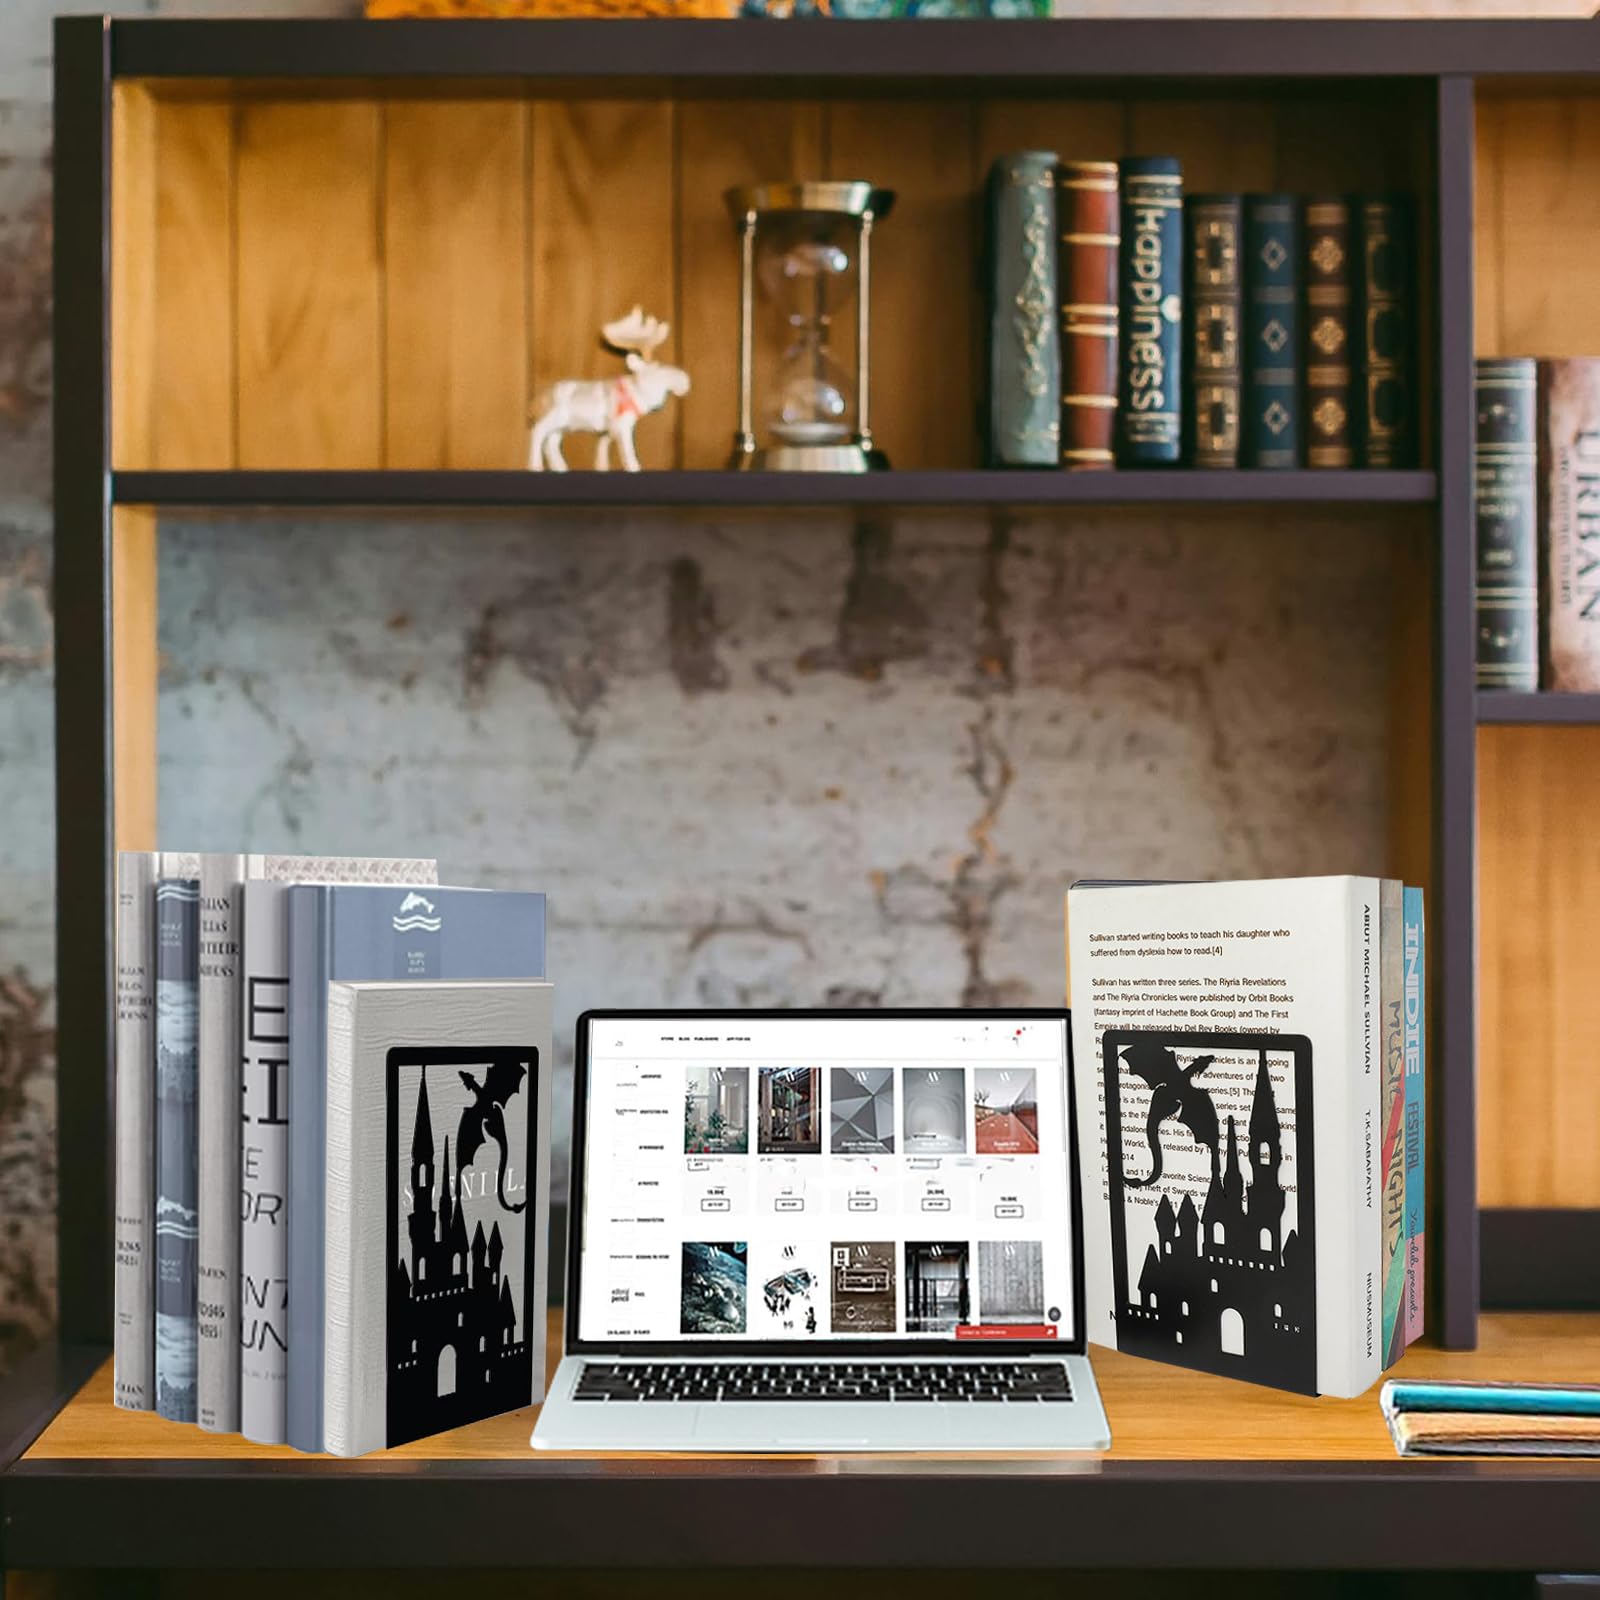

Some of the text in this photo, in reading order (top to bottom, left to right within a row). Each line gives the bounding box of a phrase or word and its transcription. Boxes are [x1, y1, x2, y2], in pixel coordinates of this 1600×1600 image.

[1130, 208, 1166, 410] Happiness
[1575, 430, 1600, 621] URBAN
[1089, 933, 1115, 942] Sullivan
[1116, 933, 1140, 941] started
[1142, 932, 1165, 942] writing
[1167, 931, 1189, 940] books
[1200, 931, 1221, 939] teach
[1223, 930, 1234, 938] his
[1236, 929, 1271, 940] daughter
[1272, 928, 1291, 937] who
[1090, 946, 1223, 957] suffered from dyslexia how to read.[4]
[1091, 978, 1117, 987] Sullivan
[1119, 978, 1131, 986] has
[1203, 978, 1218, 986] The
[1219, 978, 1240, 987] Riyria
[1242, 978, 1287, 986] Revelations
[1092, 993, 1106, 1001] and
[1107, 993, 1120, 1001] The
[1121, 993, 1140, 1002] Riyria
[1141, 993, 1178, 1001] Chronicles
[1200, 994, 1235, 1003] published
[1237, 994, 1247, 1004] by
[1248, 994, 1268, 1002] Orbit
[1269, 994, 1294, 1002] Books
[1094, 1008, 1289, 1019] (fantasy imprint of Hachette Book Group) and The First
[1120, 1023, 1130, 1031] will
[1132, 1023, 1141, 1031] be
[1142, 1024, 1172, 1032] released
[1173, 1024, 1182, 1032] by
[1184, 1024, 1197, 1032] Del
[1214, 1025, 1238, 1033] Books
[1240, 1025, 1268, 1034] (owned
[1270, 1026, 1280, 1034] by
[1405, 923, 1420, 1175] INDIE FESTIVAL
[1202, 1072, 1244, 1080] adventures
[1270, 1074, 1286, 1082] two
[1215, 1102, 1238, 1111] series
[1239, 1104, 1251, 1112] set
[1173, 1129, 1185, 1137] His
[1388, 1000, 1404, 1258] MUSIC NIGHTS
[1123, 1139, 1146, 1149] World,
[1163, 1143, 1194, 1153] released
[1194, 1145, 1204, 1155] by
[1285, 1152, 1292, 1161] in
[1126, 1168, 1139, 1176] and
[1163, 1185, 1171, 1193] of
[1172, 1186, 1198, 1197] Swords
[1134, 1197, 1159, 1207] Noble's
